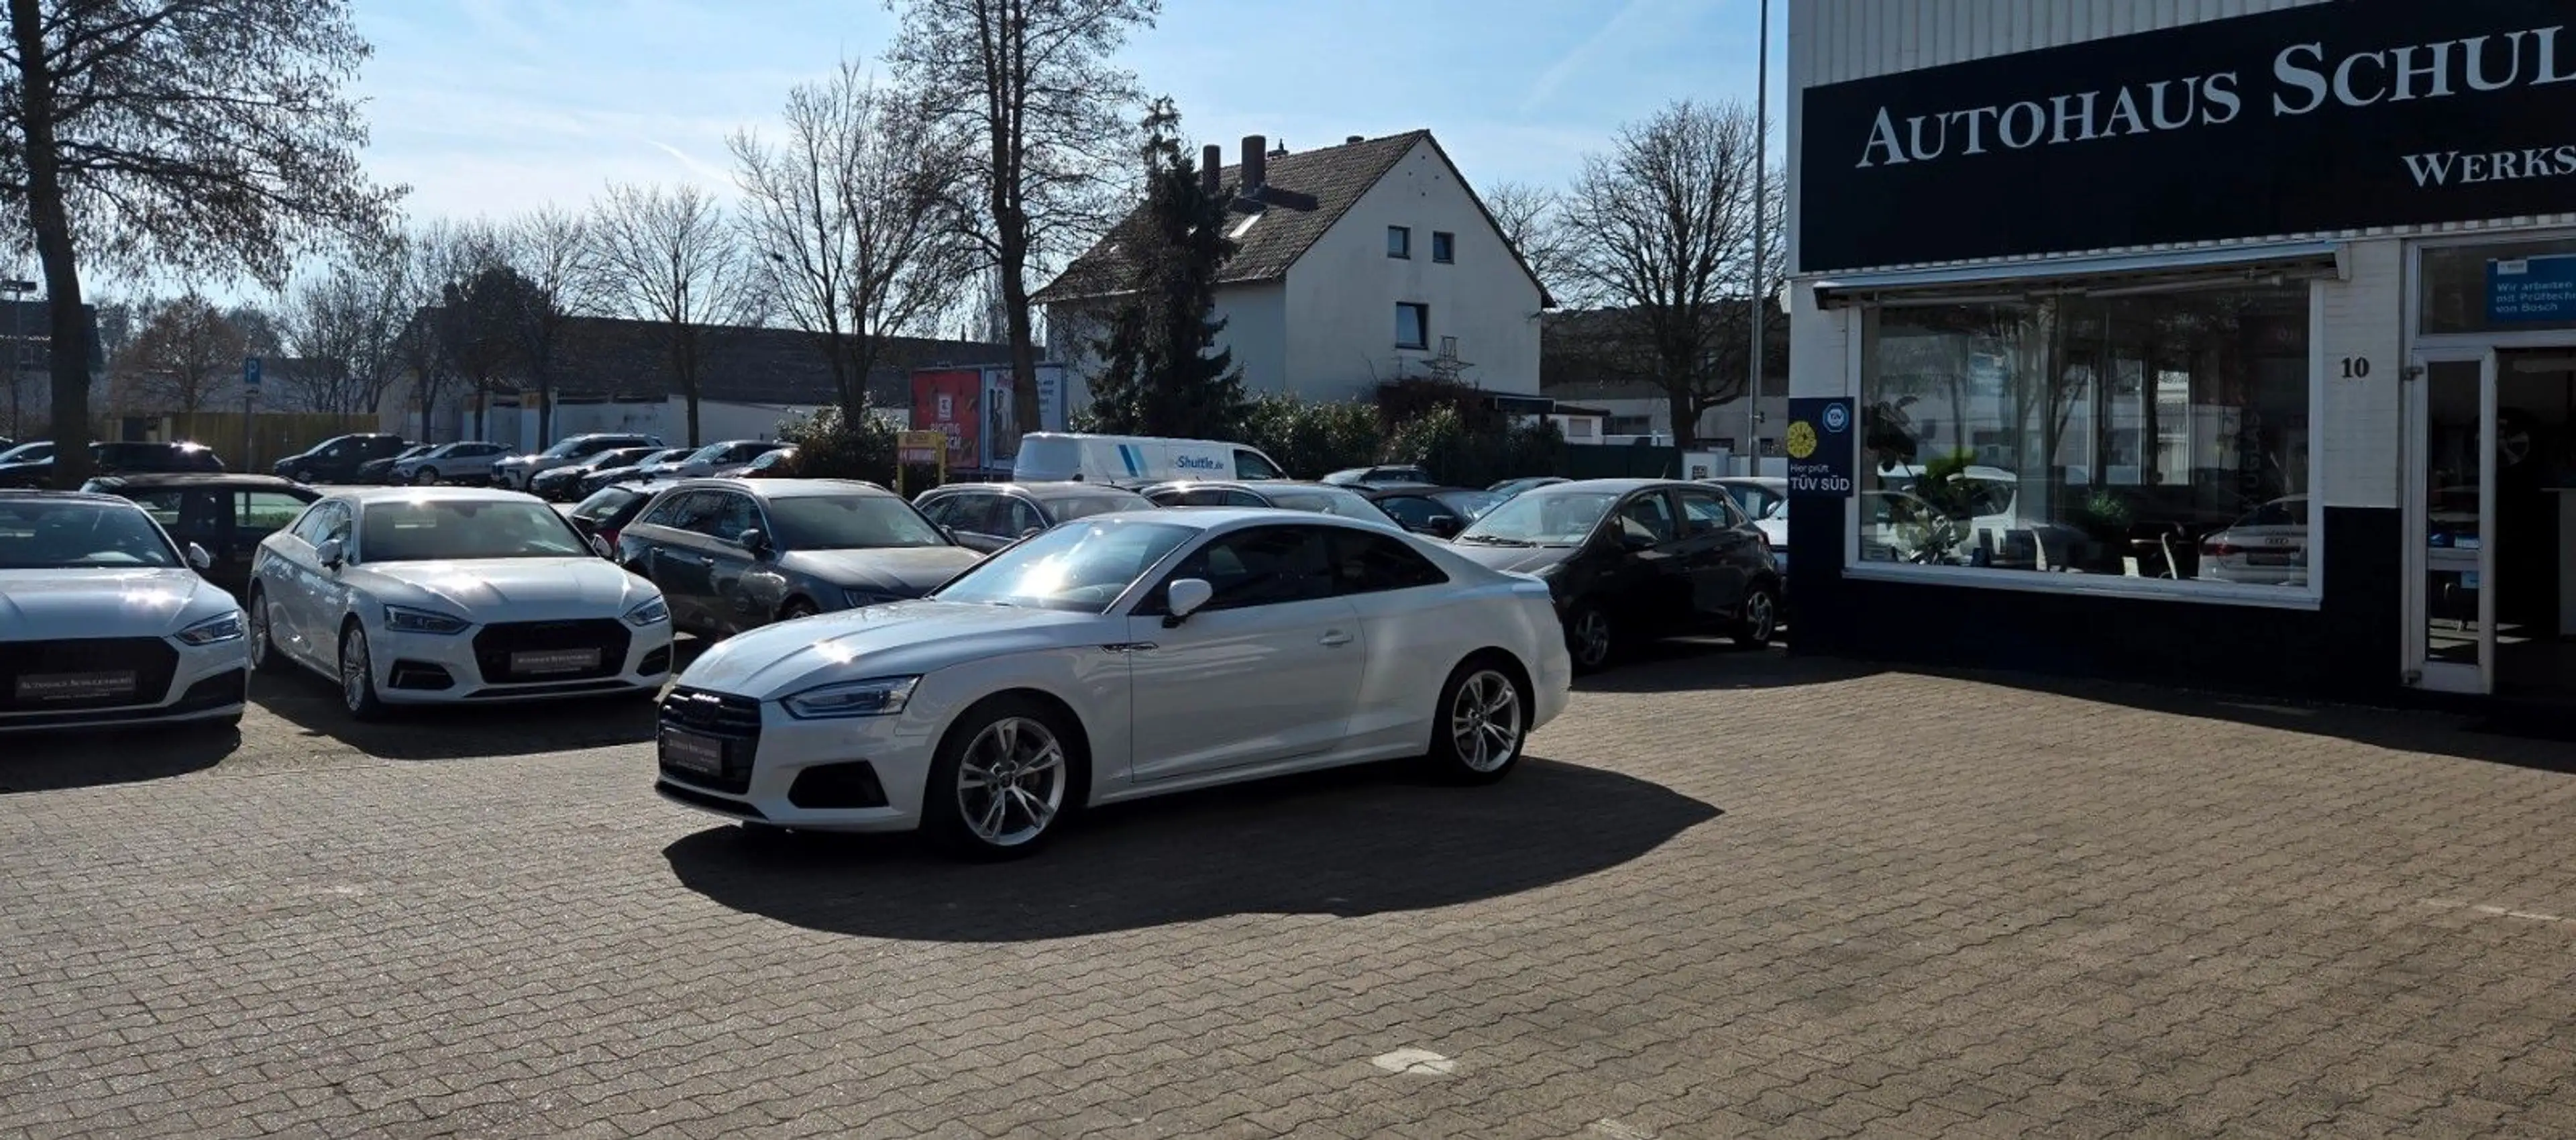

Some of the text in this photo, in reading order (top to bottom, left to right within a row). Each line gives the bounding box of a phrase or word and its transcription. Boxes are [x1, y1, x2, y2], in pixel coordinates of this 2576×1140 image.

[1855, 71, 2241, 168] AUTOHAUS
[2497, 281, 2573, 292] Wir arbeiten
[2496, 295, 2517, 303] mit
[2496, 302, 2558, 313] von Bosch
[248, 360, 258, 380] P
[2341, 357, 2369, 379] 10
[1790, 474, 1850, 491] TÜV SÜD
